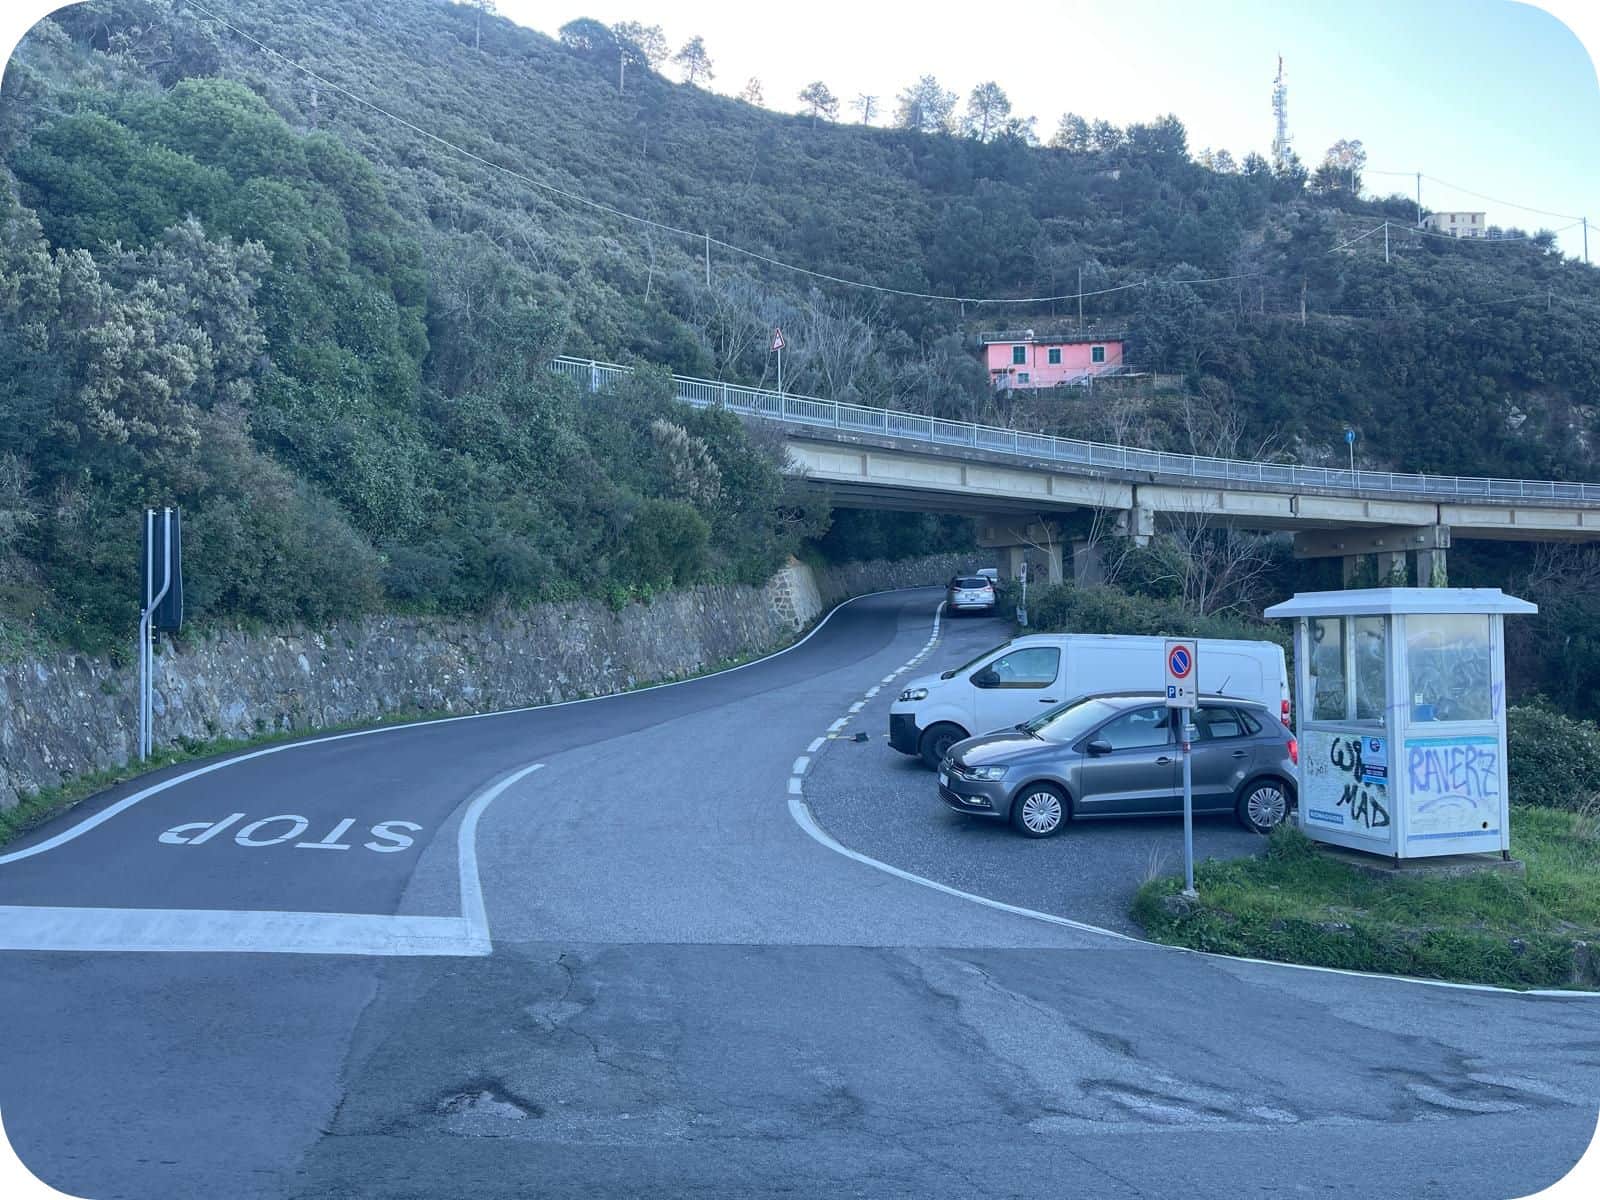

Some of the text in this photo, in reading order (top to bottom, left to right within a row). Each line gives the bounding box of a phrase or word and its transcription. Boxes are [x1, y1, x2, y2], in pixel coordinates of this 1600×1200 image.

[1168, 687, 1175, 697] P
[1336, 783, 1390, 829] MAD
[158, 813, 423, 852] STOP
